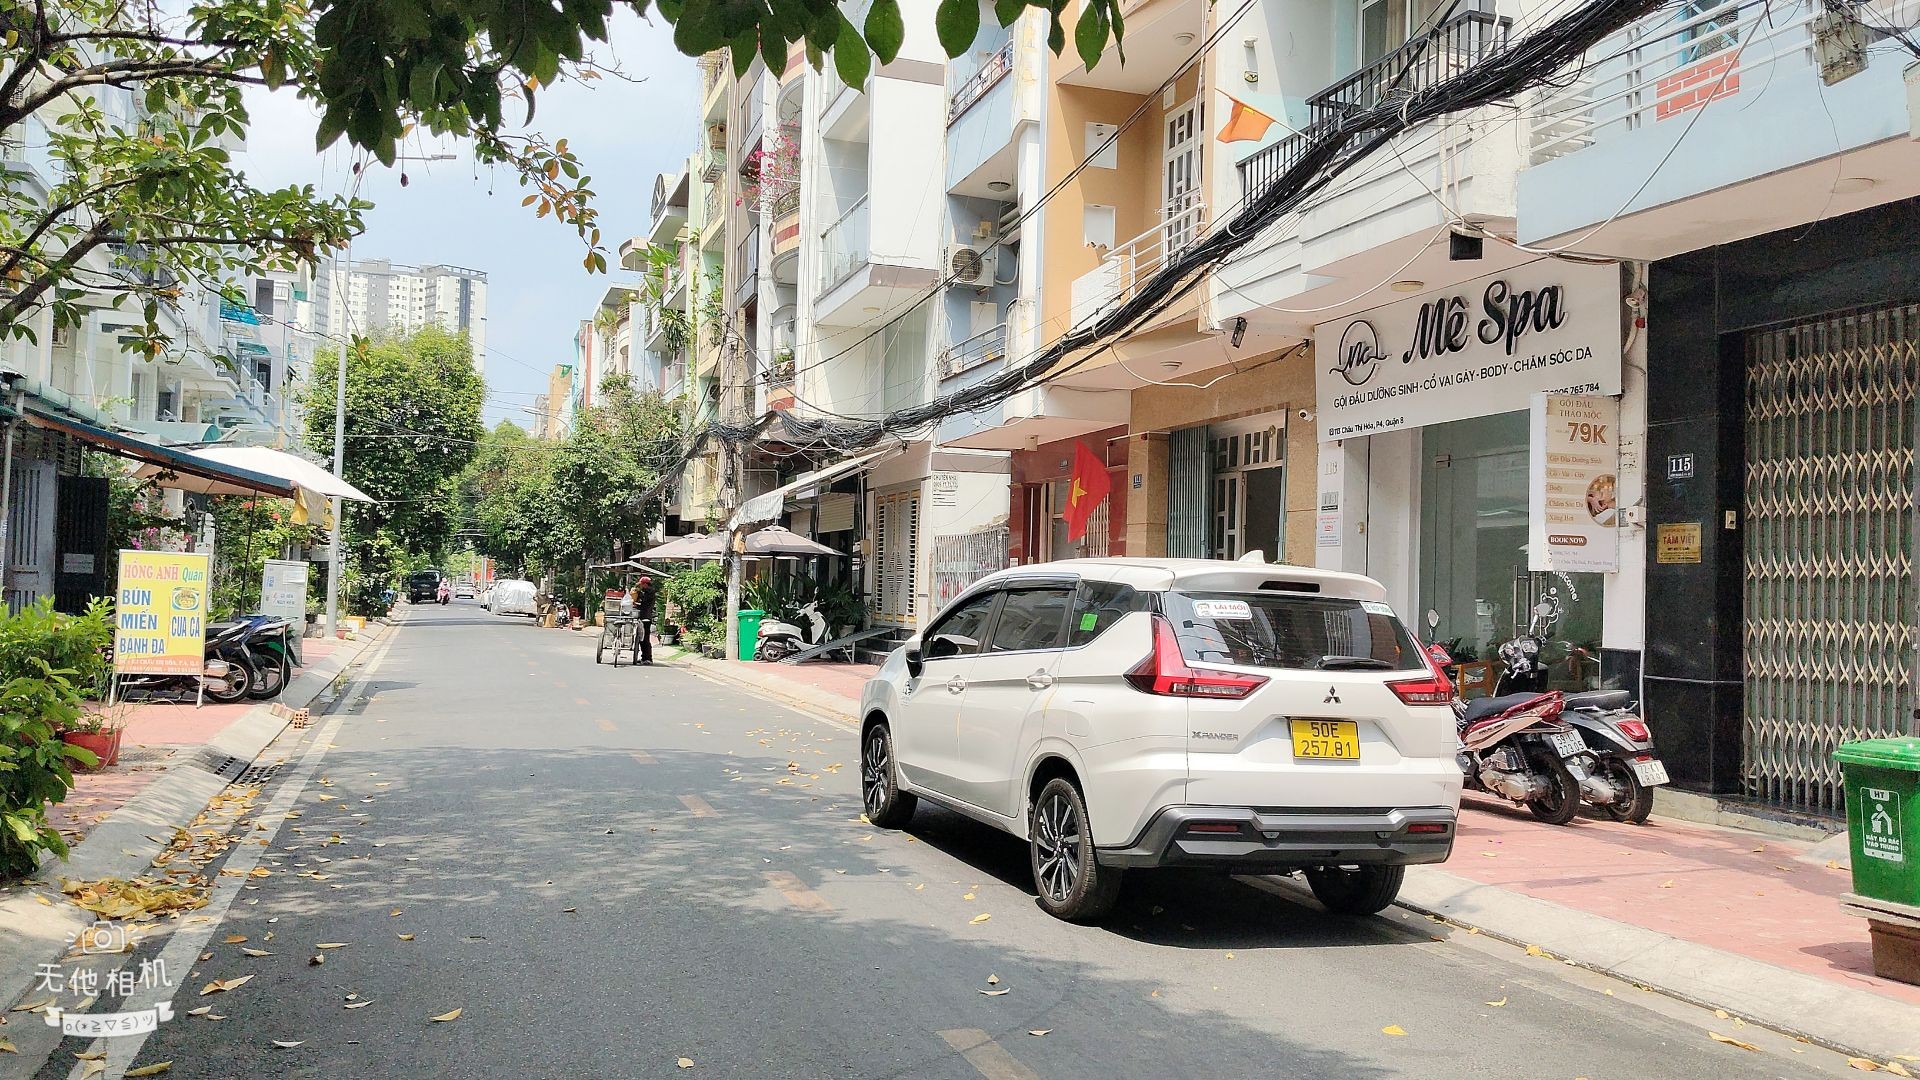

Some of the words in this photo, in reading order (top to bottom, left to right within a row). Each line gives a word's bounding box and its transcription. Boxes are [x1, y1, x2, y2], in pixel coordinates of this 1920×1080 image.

[1402, 296, 1470, 364] Mê
[1477, 280, 1568, 356] Spa
[1333, 395, 1348, 410] GỘI
[1398, 381, 1419, 396] SINH
[1438, 374, 1454, 388] VAI
[1480, 363, 1509, 380] BODY
[1549, 348, 1573, 366] SÓC
[1575, 346, 1593, 361] DA
[1570, 385, 1584, 394] 765
[1585, 382, 1600, 392] 784
[1567, 421, 1607, 444] 79K
[1671, 457, 1691, 472] 115
[122, 586, 152, 606] BÚN
[171, 615, 187, 637] CUA
[190, 612, 200, 638] CÁ
[120, 635, 148, 654] BÁNH
[151, 638, 165, 654] ĐA
[1191, 730, 1239, 741] XPANDER
[1310, 721, 1340, 739] 50E
[1300, 740, 1351, 757] 257.81
